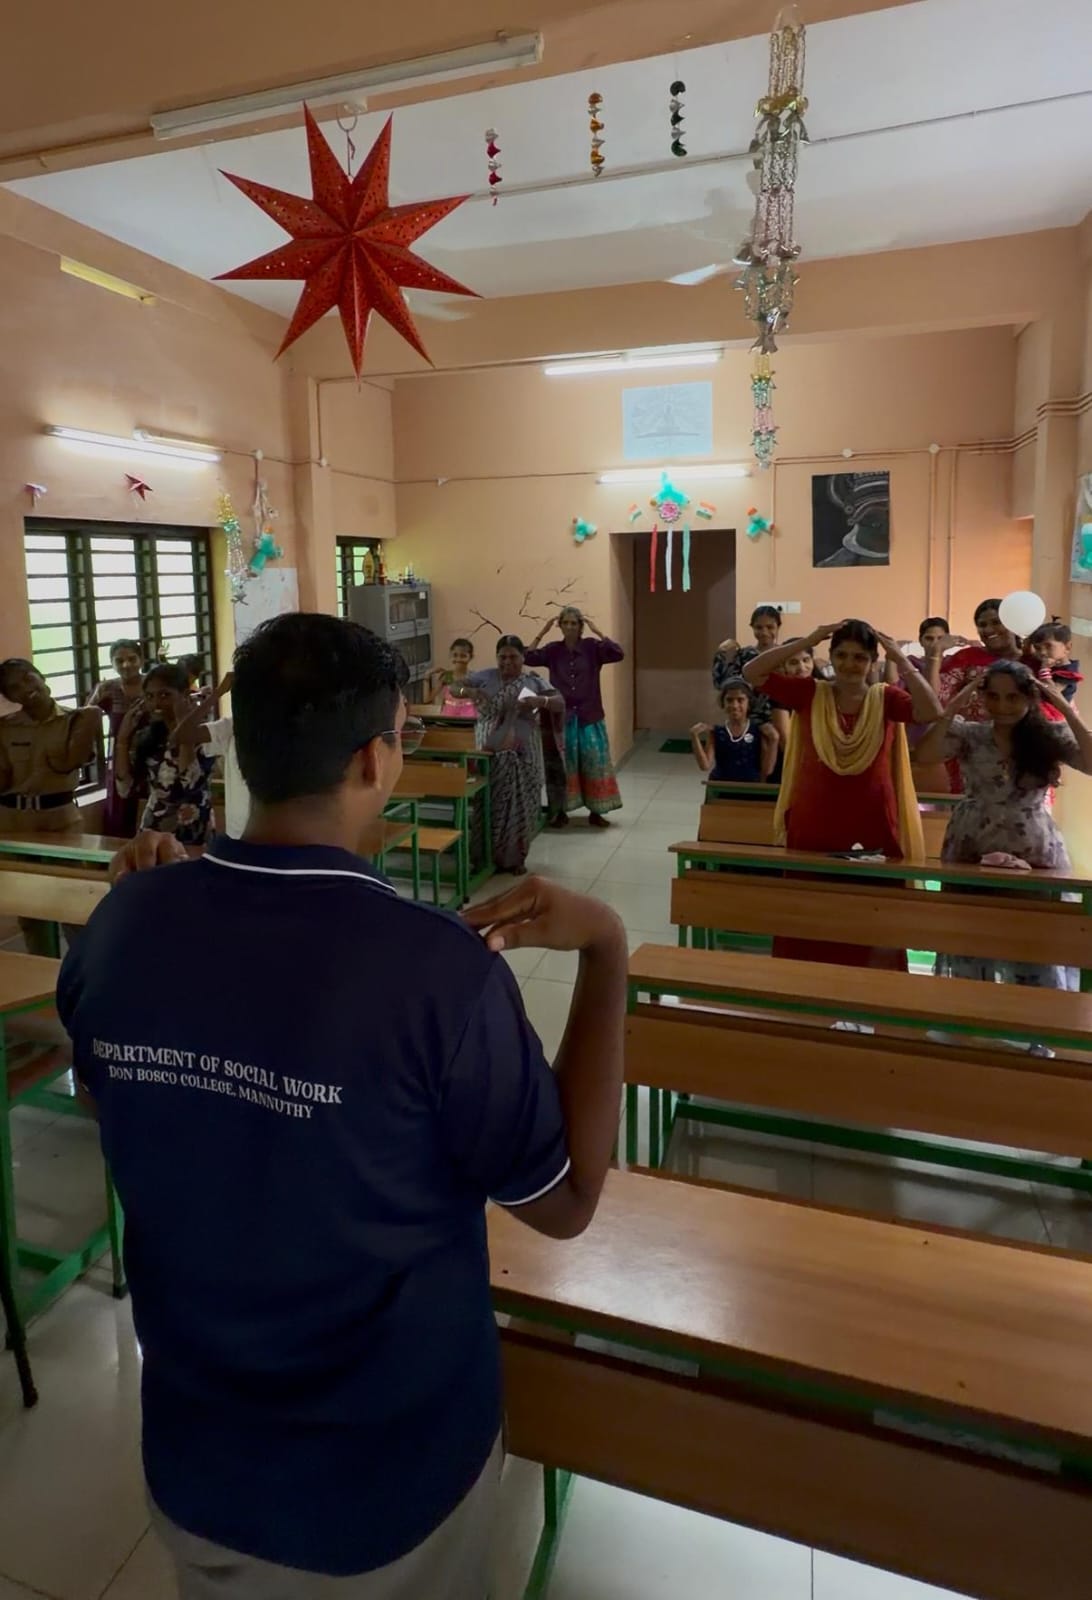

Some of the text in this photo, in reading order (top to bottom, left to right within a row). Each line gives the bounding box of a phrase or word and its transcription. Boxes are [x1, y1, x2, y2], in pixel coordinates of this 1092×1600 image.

[93, 1038, 342, 1104] DEPARTMENT OF SOCIAL WORK
[108, 1065, 133, 1080] DON
[137, 1068, 177, 1084] BOSCO
[239, 1085, 313, 1118] MANNUTHY
